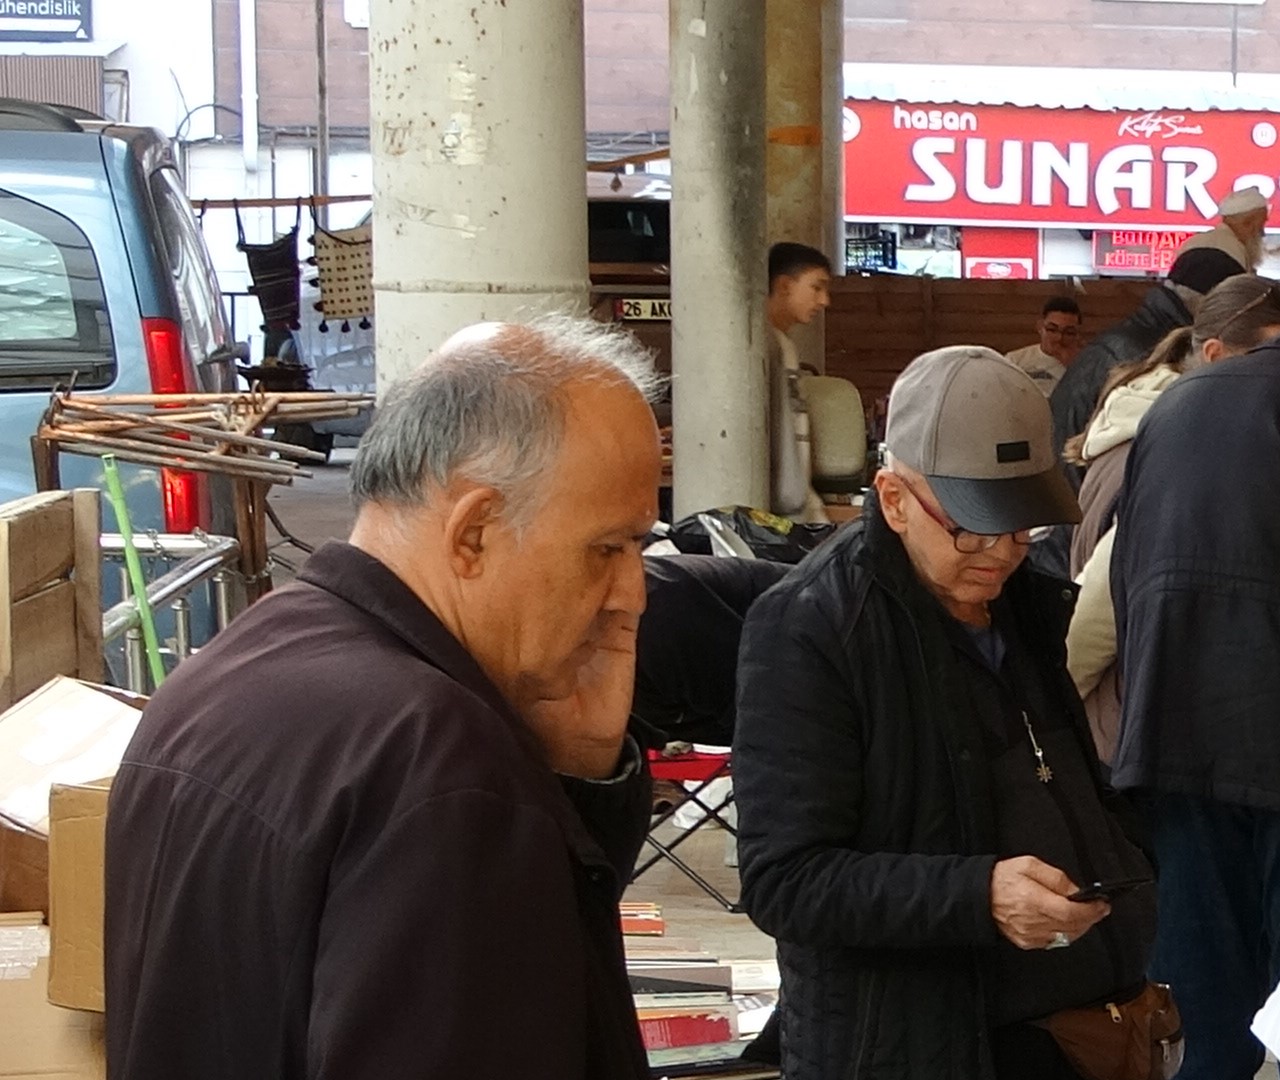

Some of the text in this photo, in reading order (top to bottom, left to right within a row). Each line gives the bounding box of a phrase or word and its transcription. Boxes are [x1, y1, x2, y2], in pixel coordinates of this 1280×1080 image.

[893, 104, 977, 132] hasan
[903, 137, 1220, 220] SUNAR
[624, 301, 642, 317] 26
